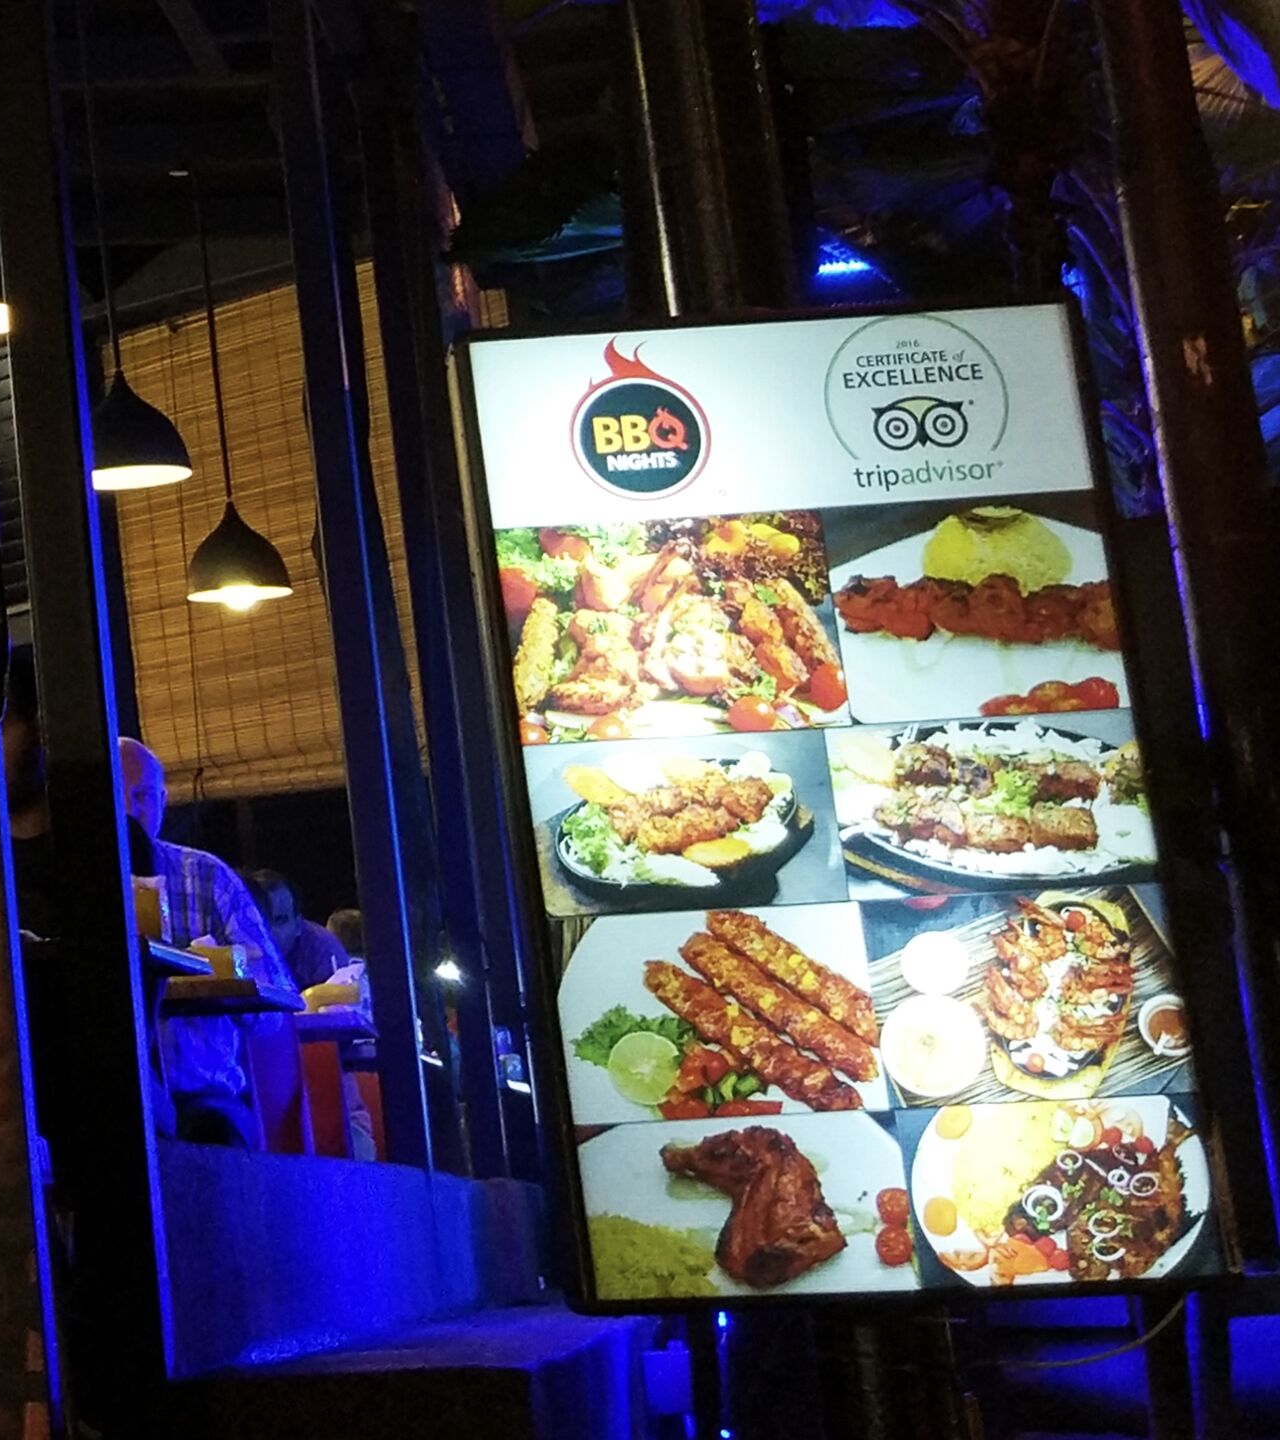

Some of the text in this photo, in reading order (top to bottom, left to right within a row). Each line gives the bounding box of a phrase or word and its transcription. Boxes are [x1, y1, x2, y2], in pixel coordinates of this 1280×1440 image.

[895, 339, 920, 349] 2016
[855, 349, 965, 368] CERTIFICATE of
[842, 363, 984, 389] EXCELLENCE
[592, 406, 689, 454] BBQ
[605, 450, 680, 472] NIGHTS
[853, 460, 997, 492] tripadvisor
